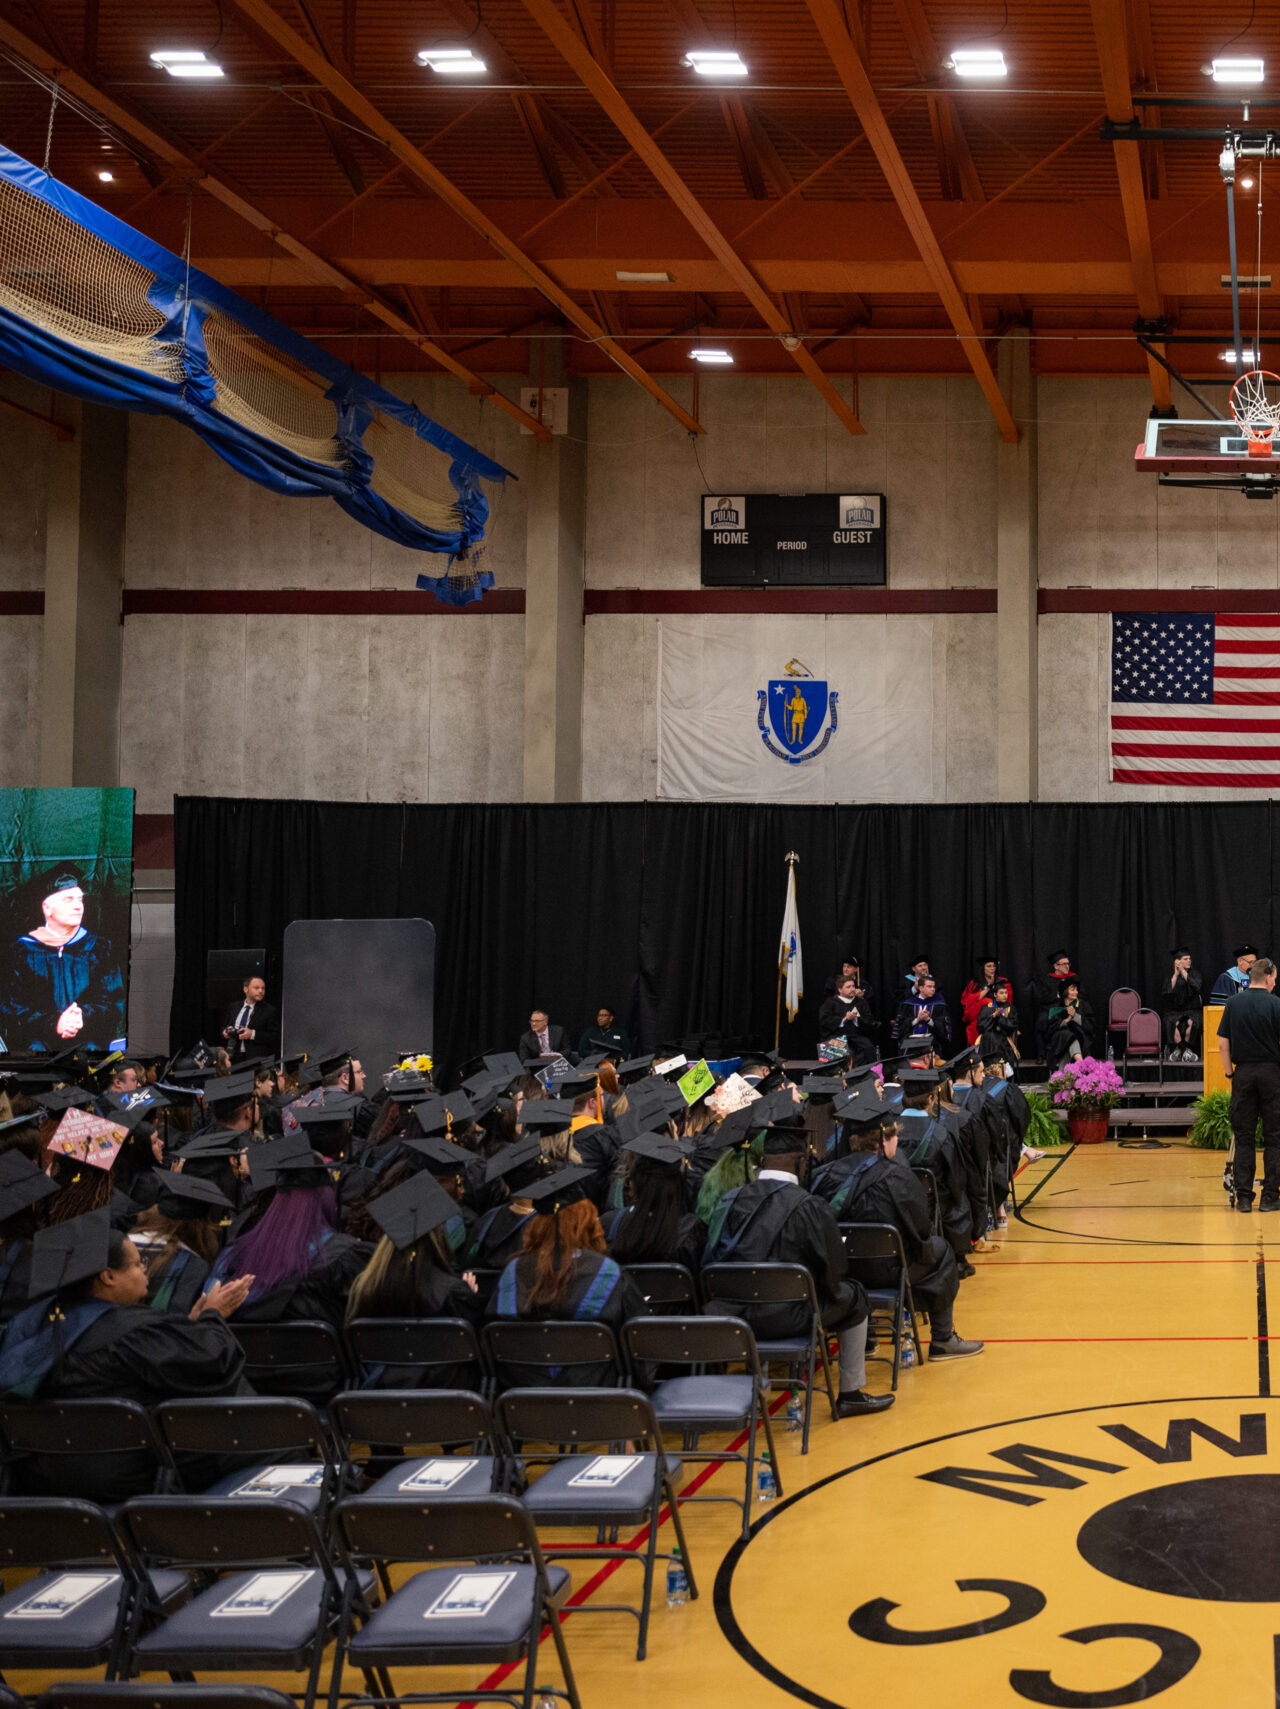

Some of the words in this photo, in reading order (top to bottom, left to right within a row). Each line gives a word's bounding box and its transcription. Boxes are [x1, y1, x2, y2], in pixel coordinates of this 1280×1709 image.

[713, 510, 737, 523] POLAR
[848, 509, 872, 522] POLAR
[713, 531, 749, 545] HOME
[833, 531, 873, 544] GUEST
[777, 541, 807, 550] PERIOD
